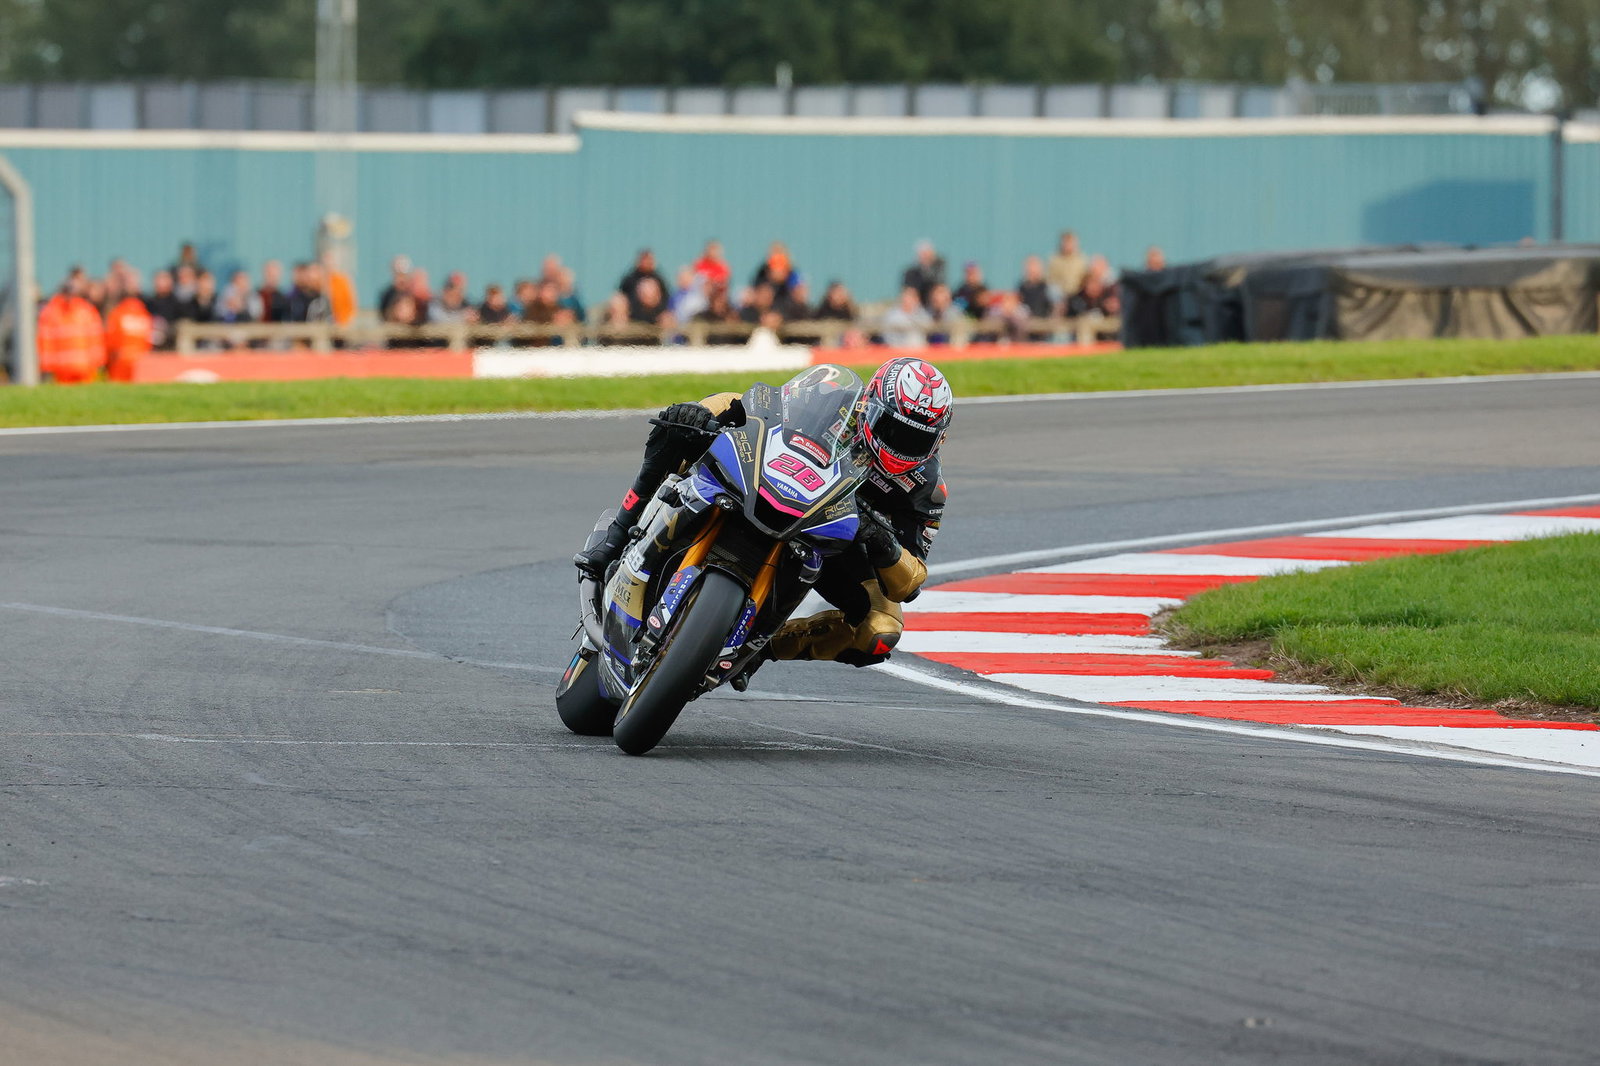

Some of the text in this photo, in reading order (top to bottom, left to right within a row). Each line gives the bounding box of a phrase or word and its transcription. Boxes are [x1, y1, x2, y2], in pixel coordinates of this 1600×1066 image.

[903, 400, 939, 419] SHARK
[739, 430, 755, 463] RICH
[805, 441, 829, 463] Bennetts
[767, 452, 826, 492] 28
[775, 481, 799, 499] YAMAHA
[824, 499, 853, 516] RICH
[669, 574, 693, 609] PIRELLI
[730, 609, 752, 645] PIRELLI
